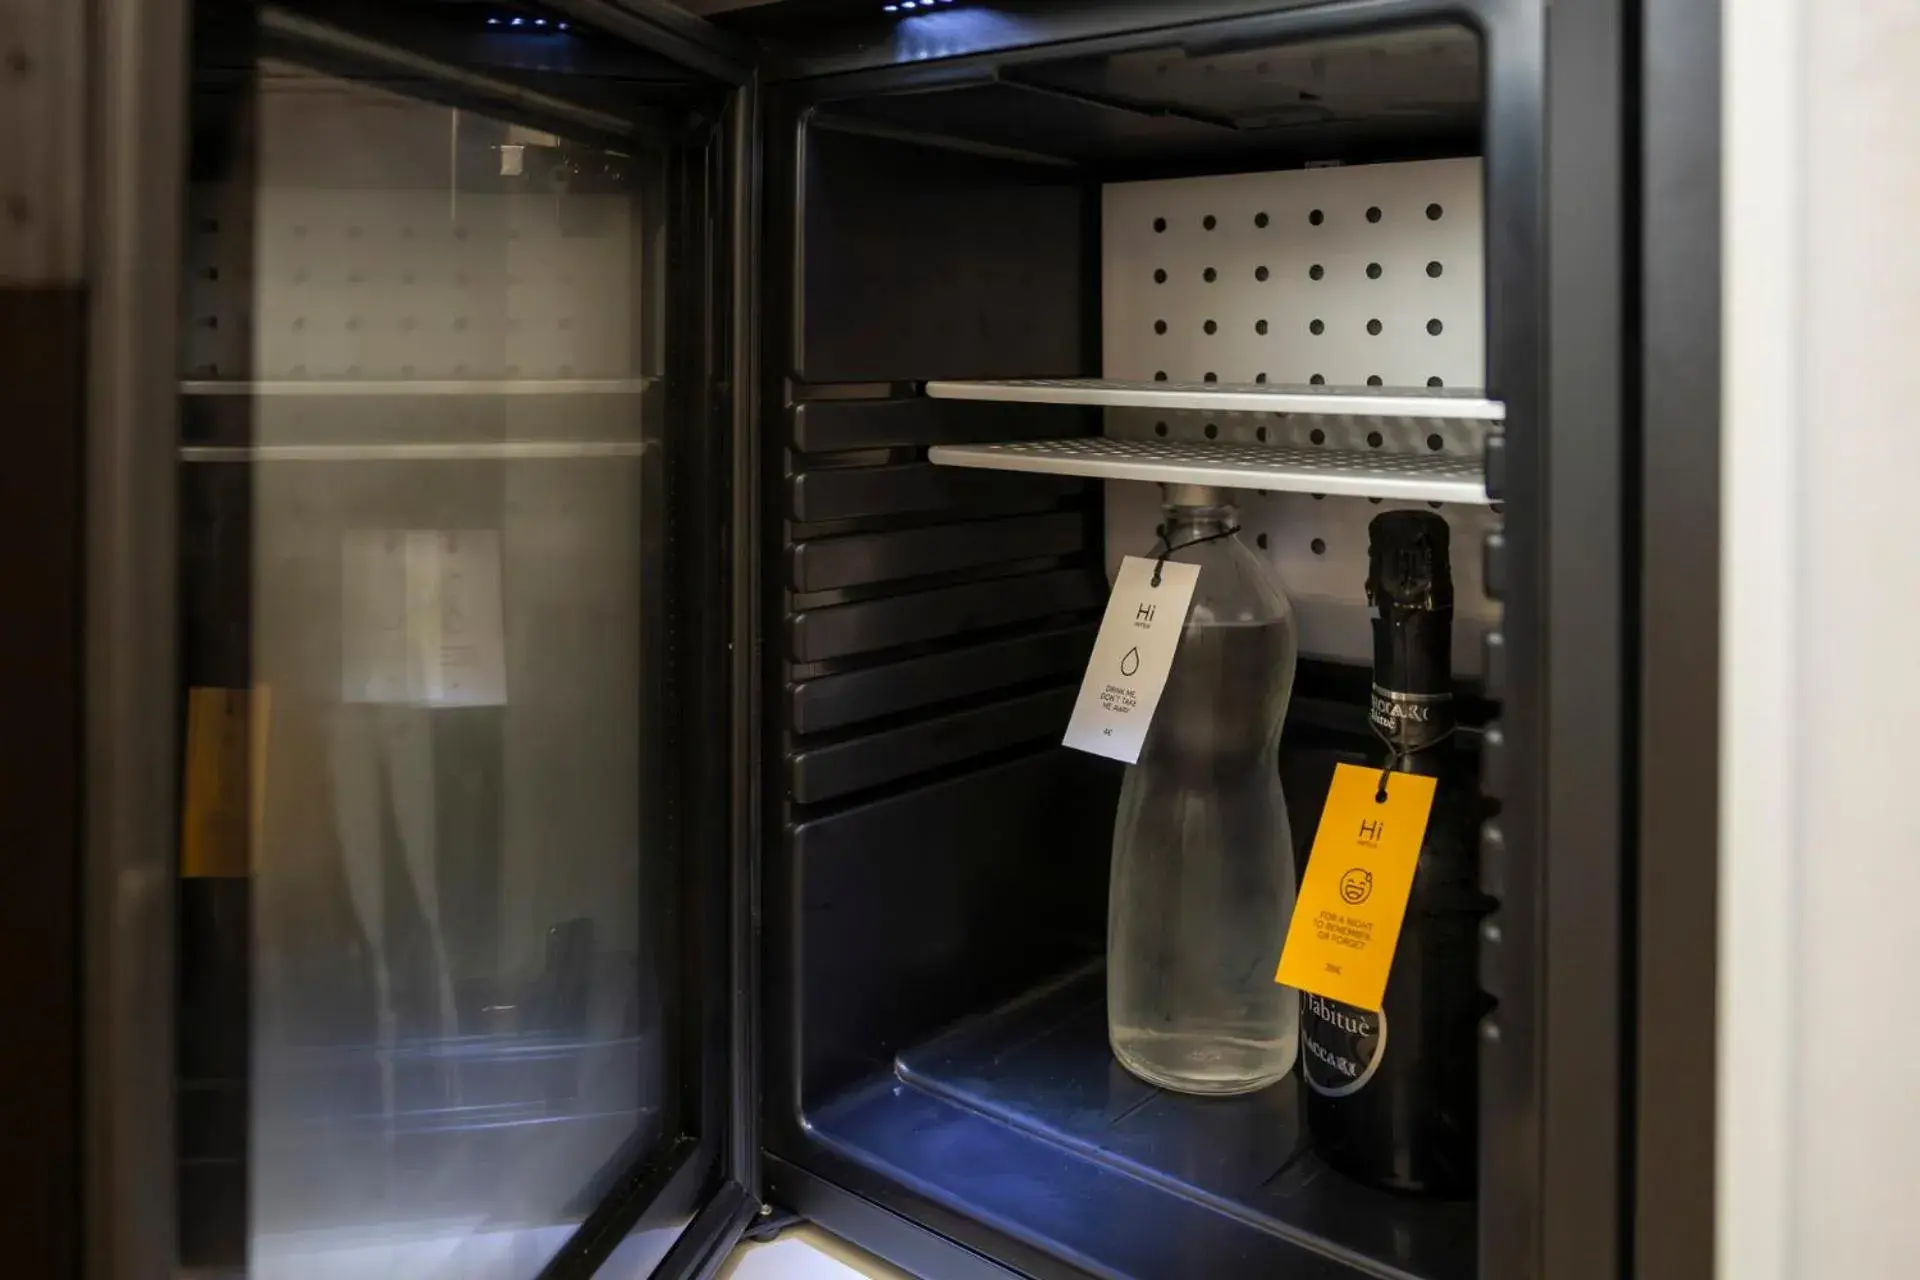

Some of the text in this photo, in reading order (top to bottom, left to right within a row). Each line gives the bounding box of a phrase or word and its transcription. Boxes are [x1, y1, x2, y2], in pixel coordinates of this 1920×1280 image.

[1136, 602, 1156, 622] Hi
[1359, 818, 1384, 841] Hi
[1320, 910, 1337, 921] FOR
